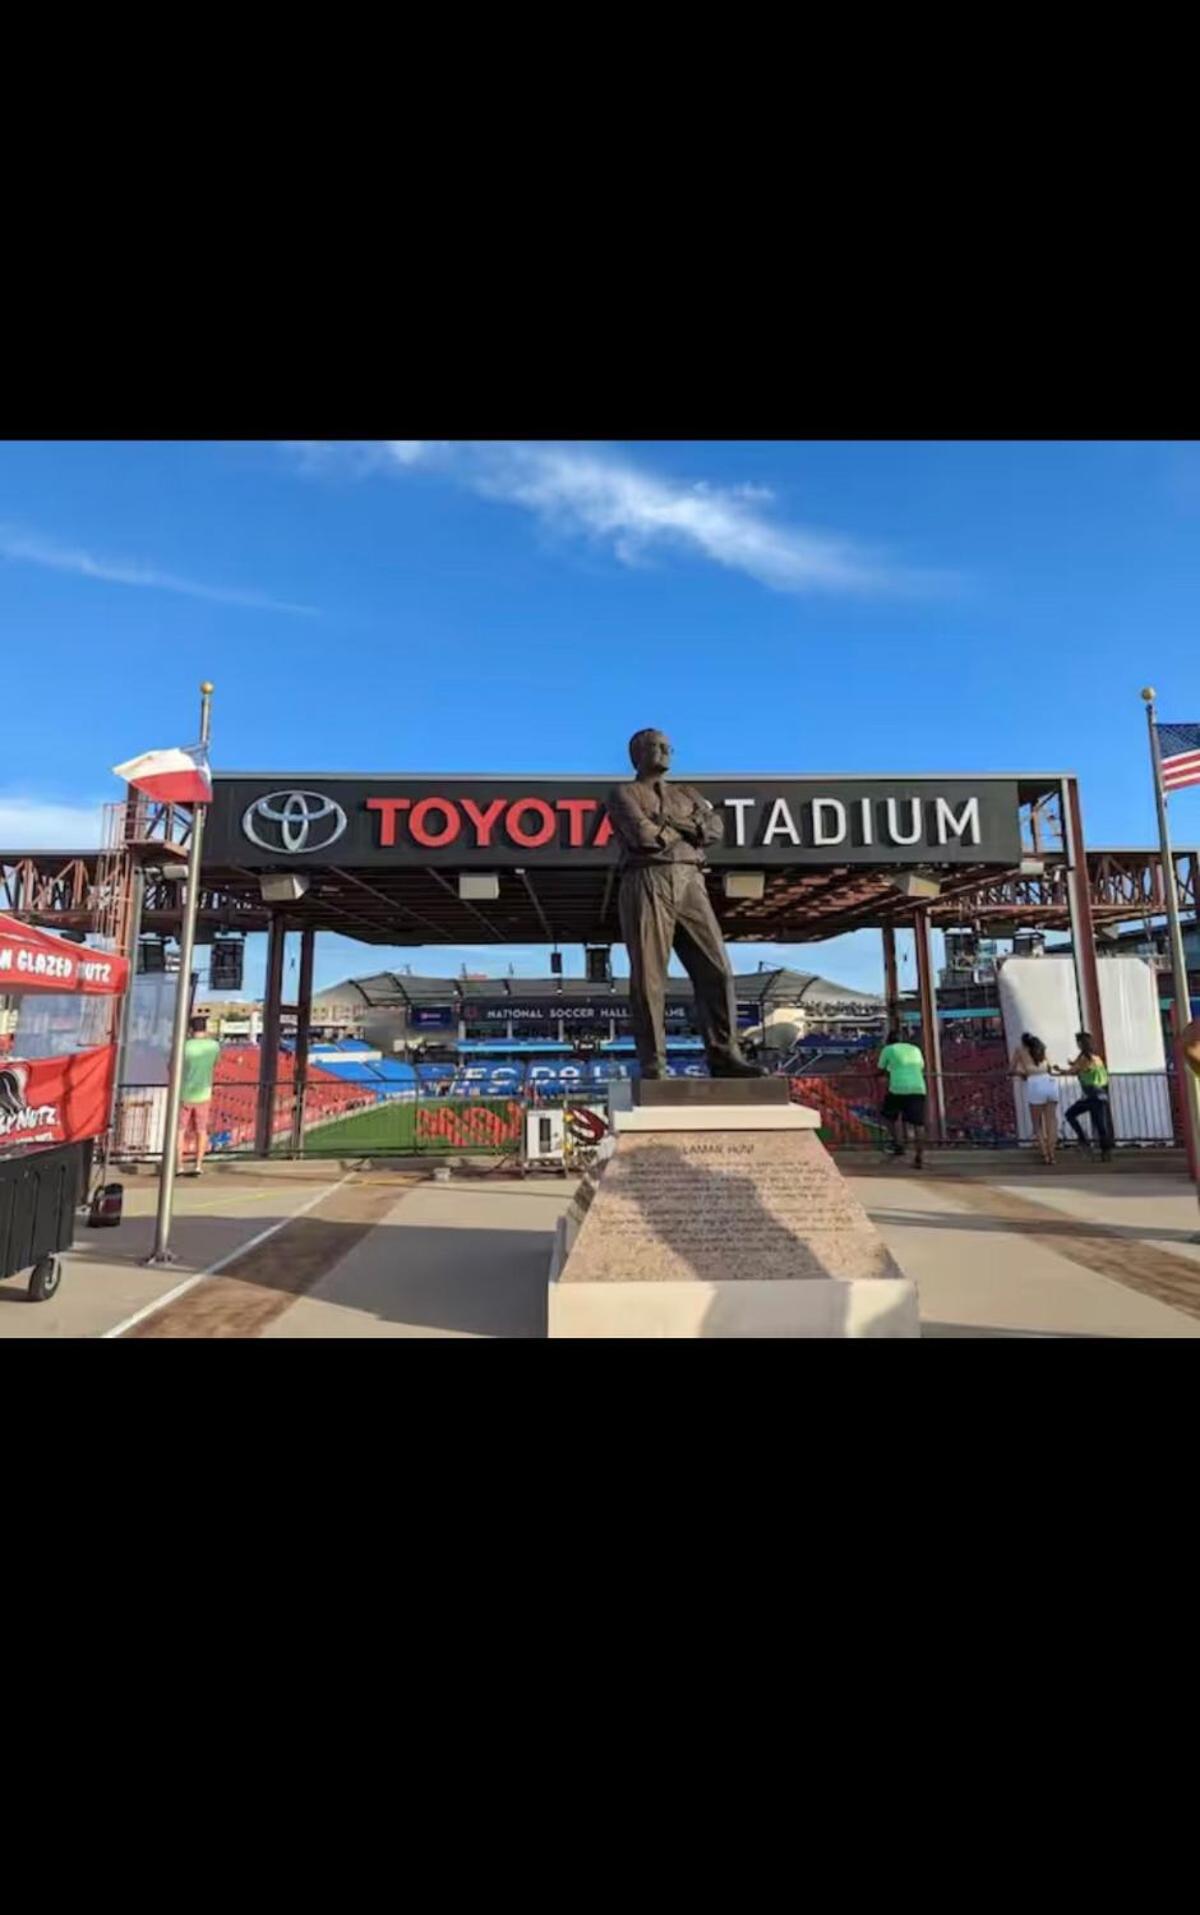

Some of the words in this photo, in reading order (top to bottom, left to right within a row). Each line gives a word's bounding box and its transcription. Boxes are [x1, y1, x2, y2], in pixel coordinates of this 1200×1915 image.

[706, 796, 981, 846] TADIUM
[487, 1008, 543, 1018] NATIONAL
[550, 1008, 594, 1018] SOCCER
[601, 1008, 628, 1018] HALL
